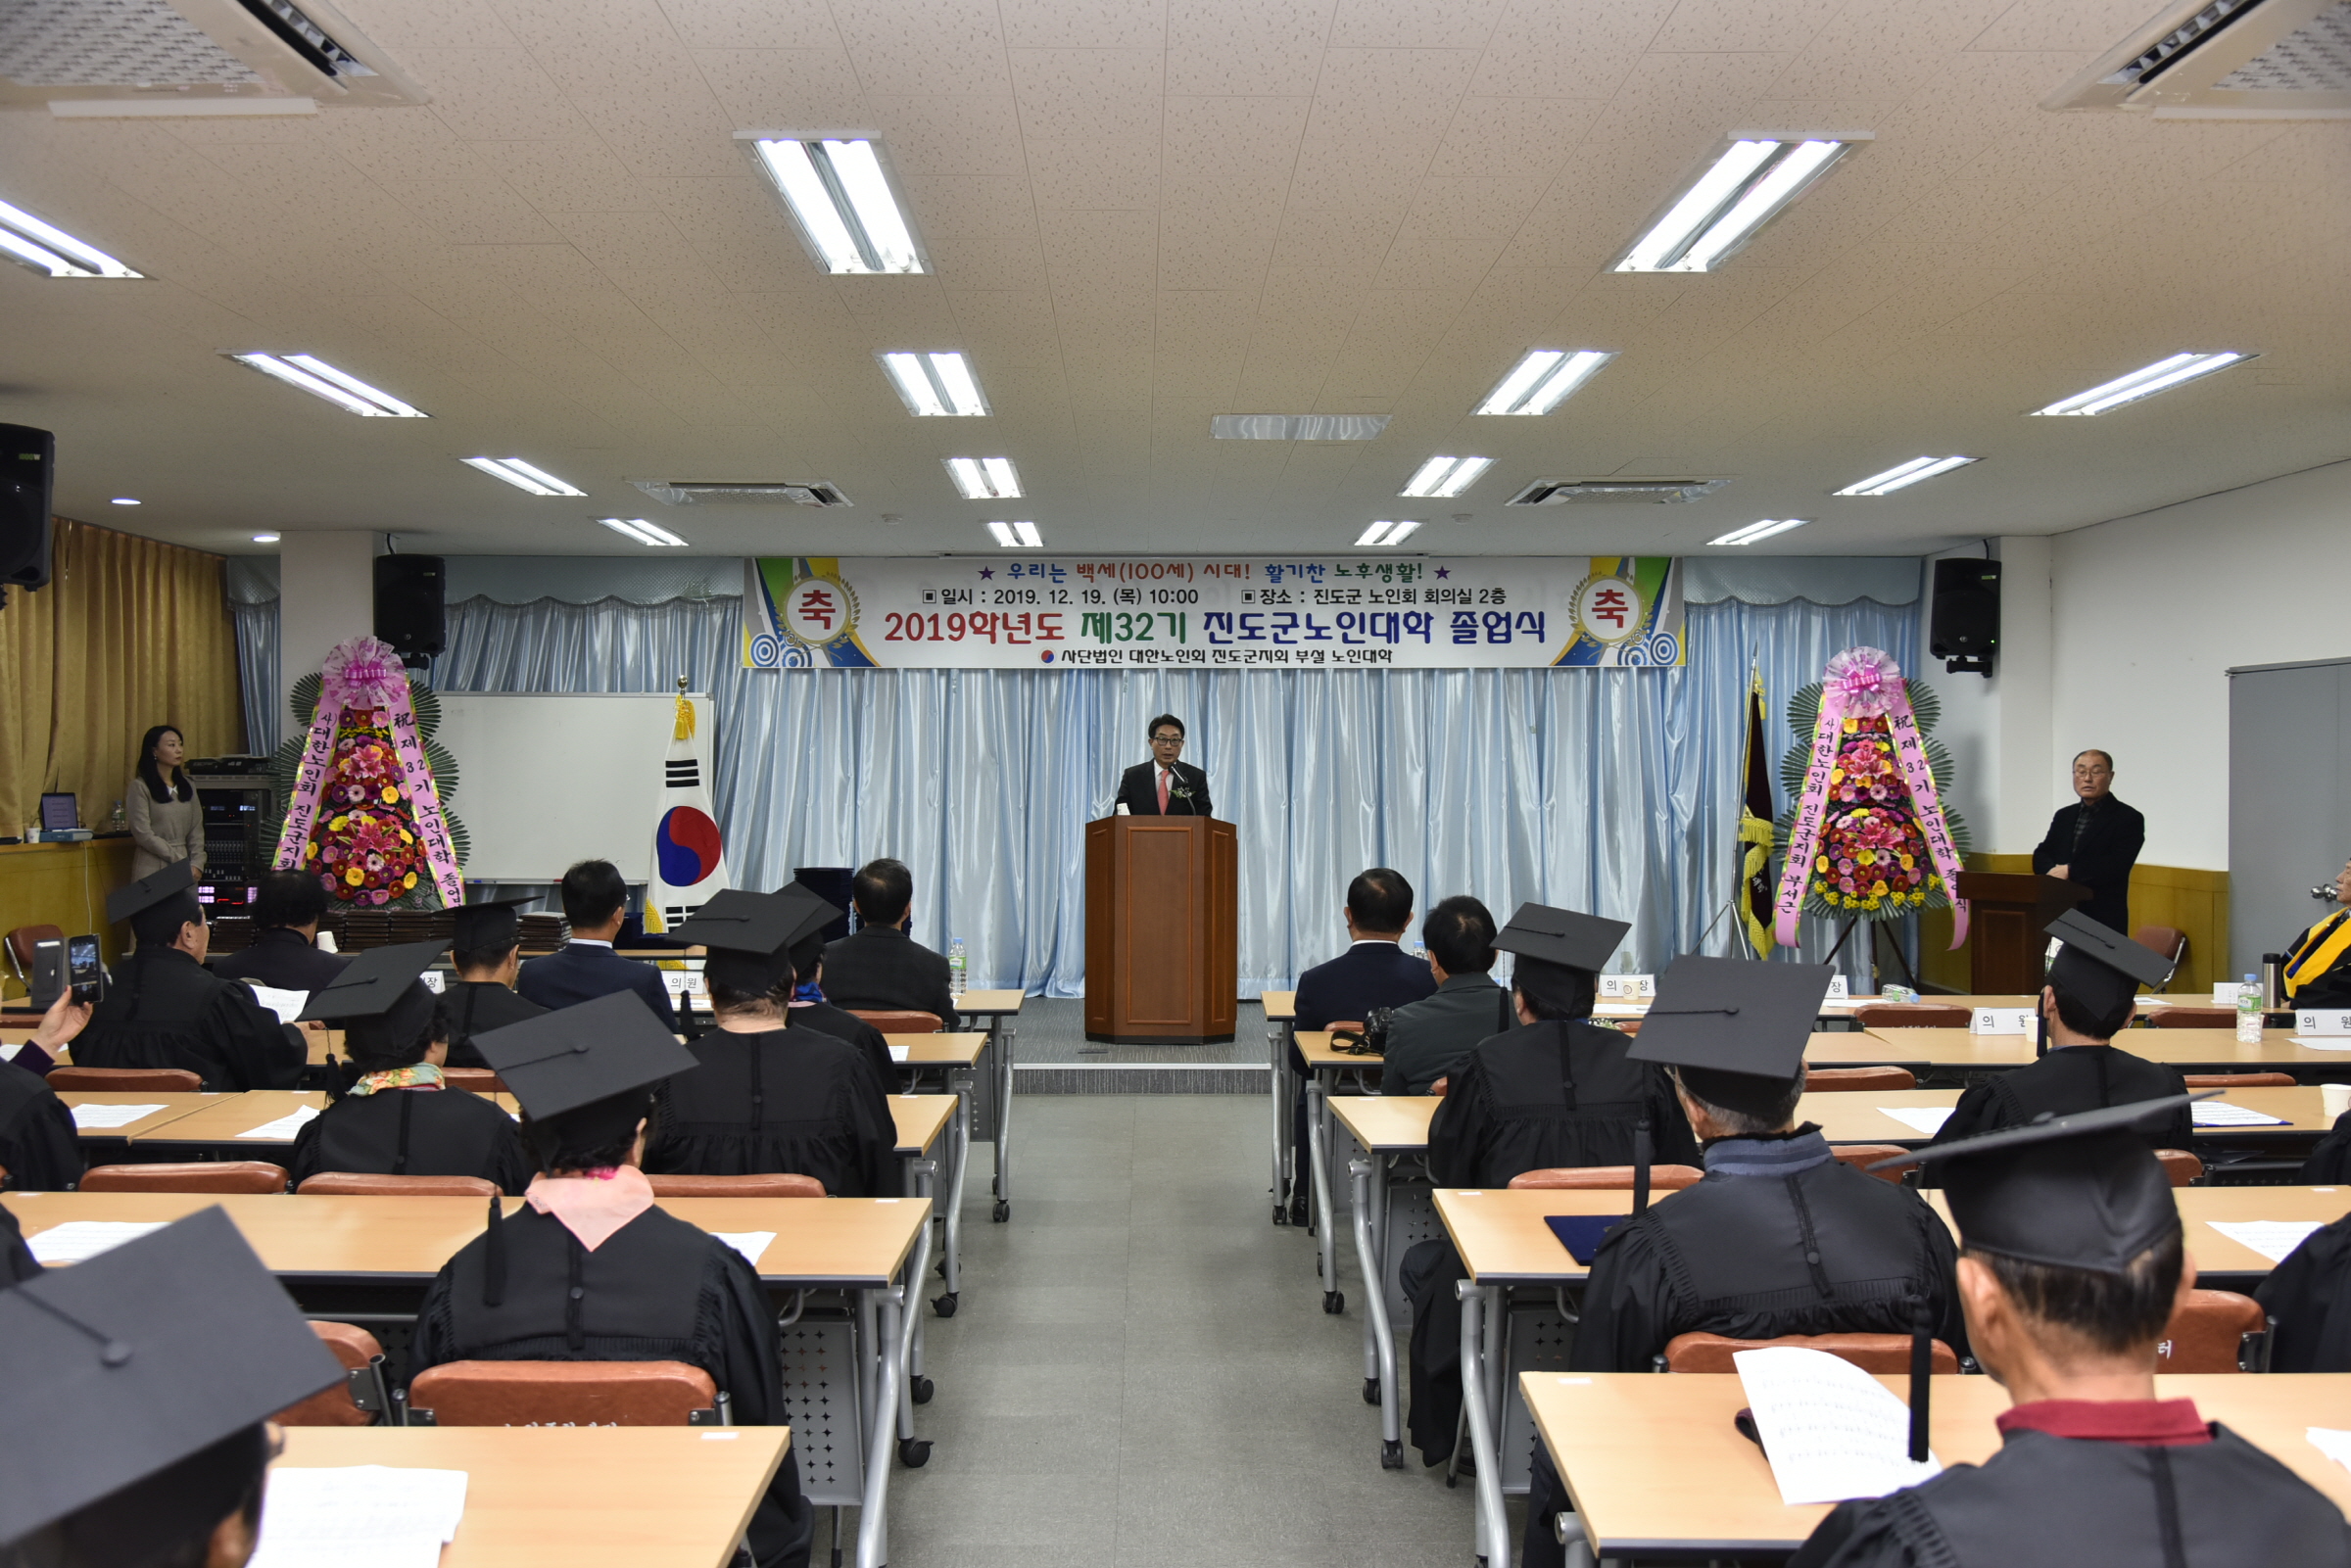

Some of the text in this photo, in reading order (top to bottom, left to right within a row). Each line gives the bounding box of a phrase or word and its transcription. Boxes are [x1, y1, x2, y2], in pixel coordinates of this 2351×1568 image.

[1007, 562, 1422, 584] 우리는 백세(100세) 시대! 활기찬 노후생활!
[798, 590, 837, 630] 축
[941, 589, 973, 605] 일시
[993, 589, 1041, 604] 2019.
[1049, 589, 1074, 604] 12.
[1081, 589, 1106, 604] 19.
[1113, 588, 1142, 605] (목)
[1149, 589, 1199, 604] 10:00
[1260, 589, 1293, 605] 장소
[1314, 589, 1363, 605] 진도군
[1368, 589, 1416, 605] 노인회
[1423, 589, 1472, 605] 회의실
[1478, 588, 1507, 604] 2층
[1591, 589, 1629, 629] 축
[885, 610, 1545, 644] 2019학년도 제32기 진도군노인대학 졸업식
[1061, 649, 1393, 664] 사단법인 대한노인회 진도군지회 부설 노인대학
[394, 712, 415, 729] 祝
[418, 805, 451, 865] 노인대학
[1894, 715, 1914, 731] 祝
[1920, 805, 1953, 861] 노인대학
[277, 804, 312, 869] 진도군지회
[1789, 803, 1818, 868] 진도군지회
